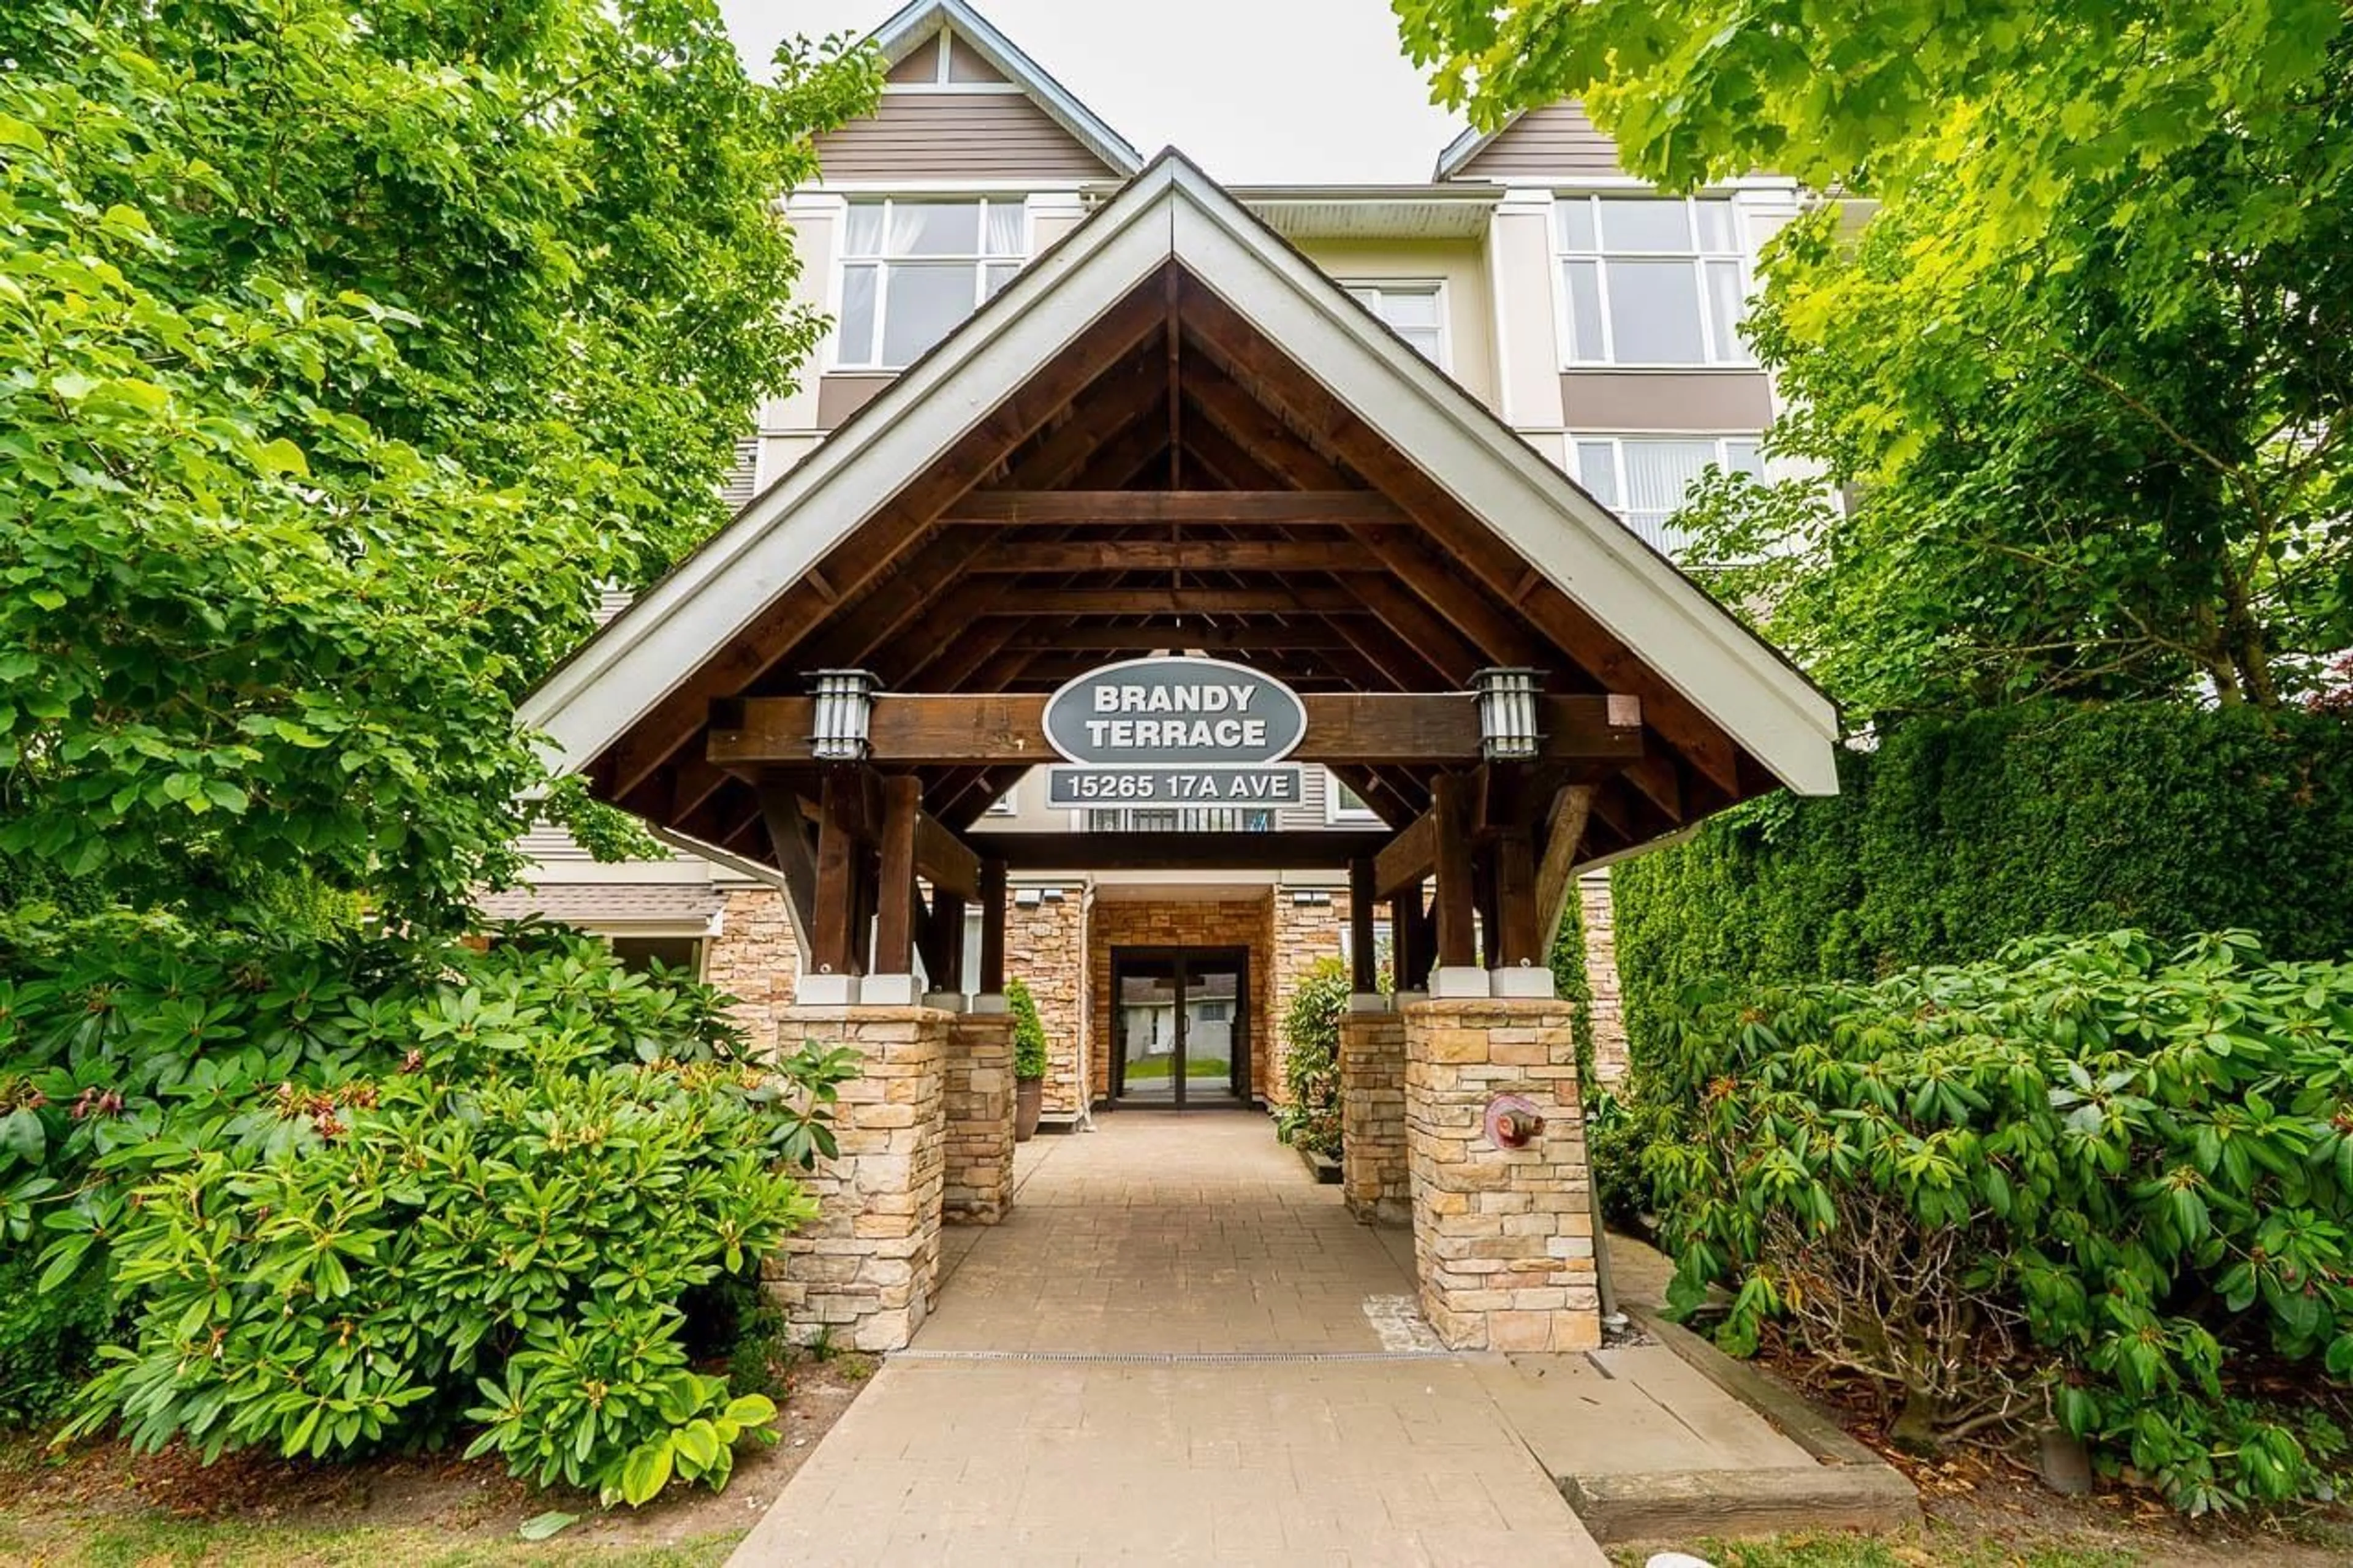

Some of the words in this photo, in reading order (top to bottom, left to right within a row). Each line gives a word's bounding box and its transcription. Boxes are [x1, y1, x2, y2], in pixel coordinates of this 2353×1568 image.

[1094, 685, 1256, 713] BRANDY
[1085, 719, 1267, 748] TERRACE
[1068, 776, 1154, 797] 15265
[1167, 776, 1218, 797] 17A
[1229, 776, 1289, 797] AVE
